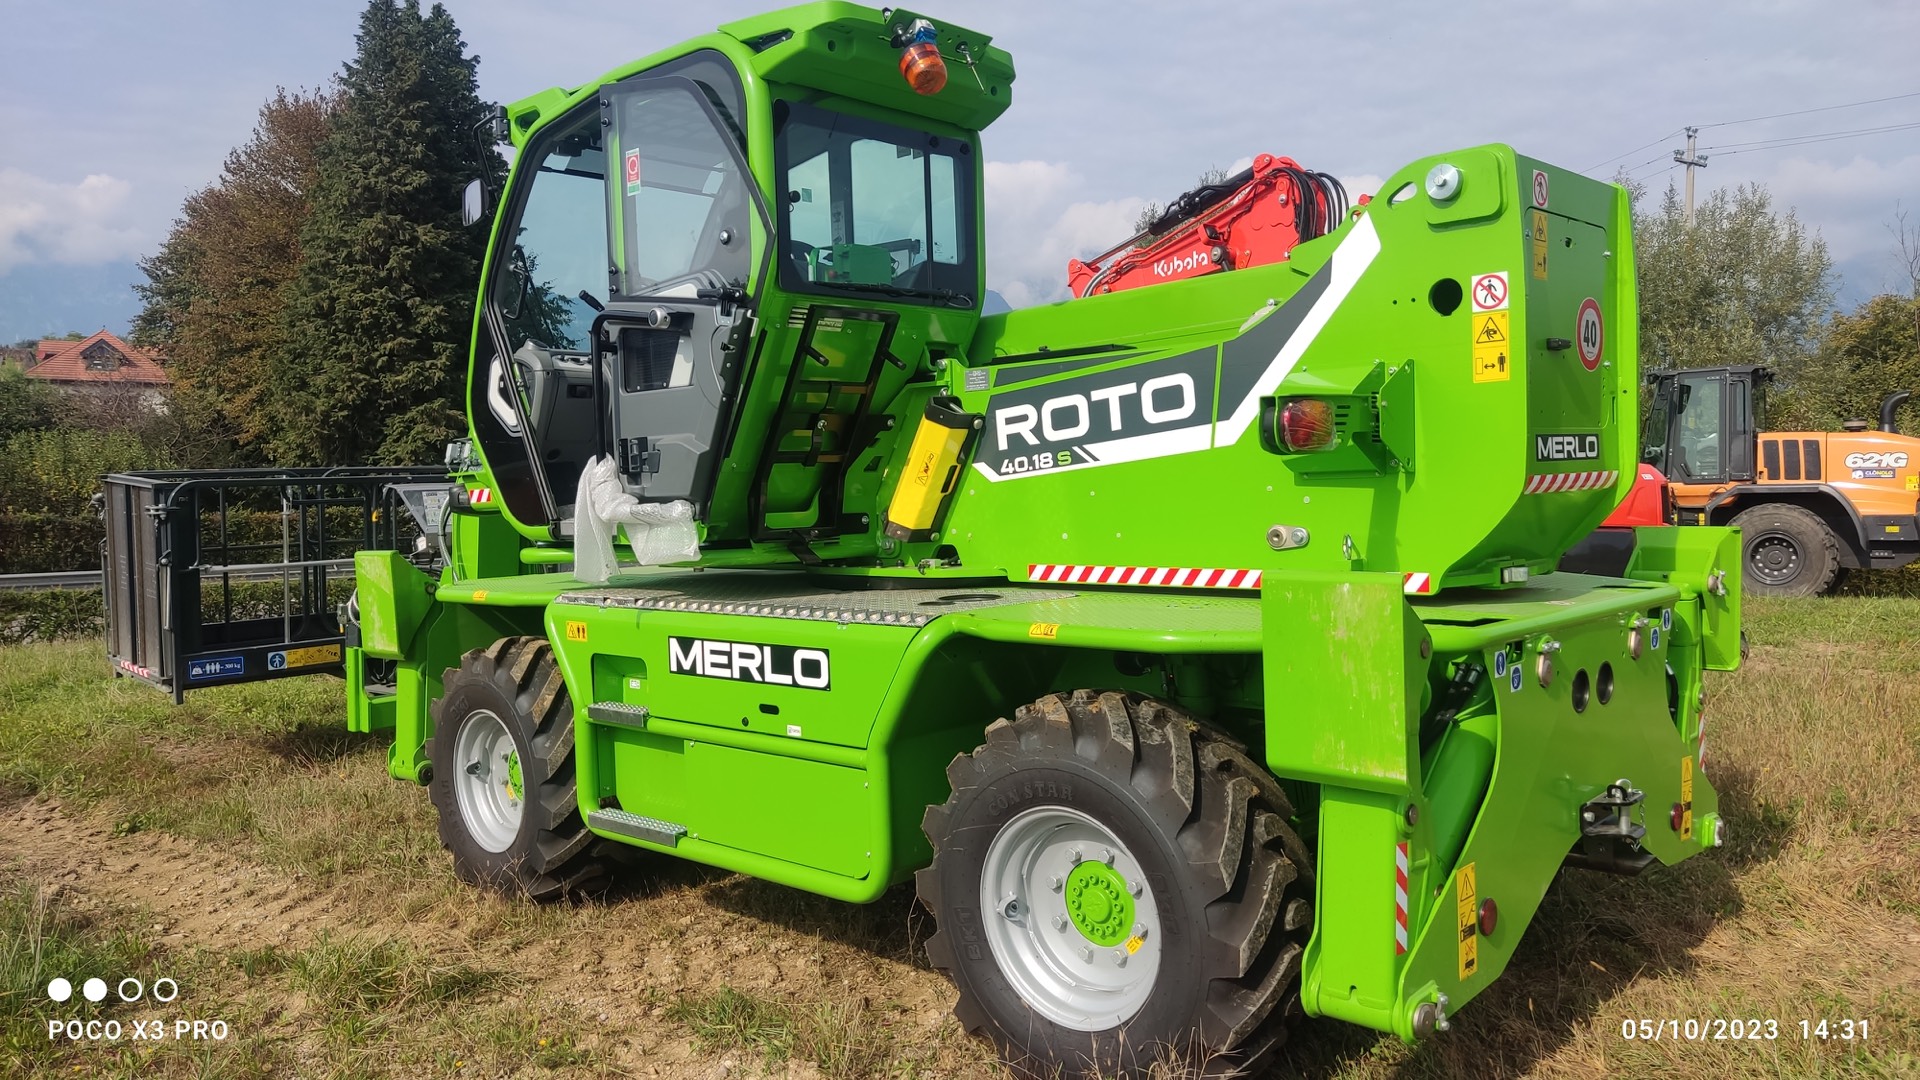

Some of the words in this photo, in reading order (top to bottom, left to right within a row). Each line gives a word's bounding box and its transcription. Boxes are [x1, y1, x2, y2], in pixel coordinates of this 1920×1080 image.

[1153, 250, 1209, 277] Kubota
[1583, 319, 1597, 348] 40
[995, 372, 1196, 450] ROTO
[1537, 436, 1598, 460] MERLO
[1845, 452, 1909, 468] 621G
[1000, 452, 1054, 474] 40.18
[1057, 451, 1072, 466] S
[669, 637, 829, 688] MERLO
[955, 907, 983, 960] BKT
